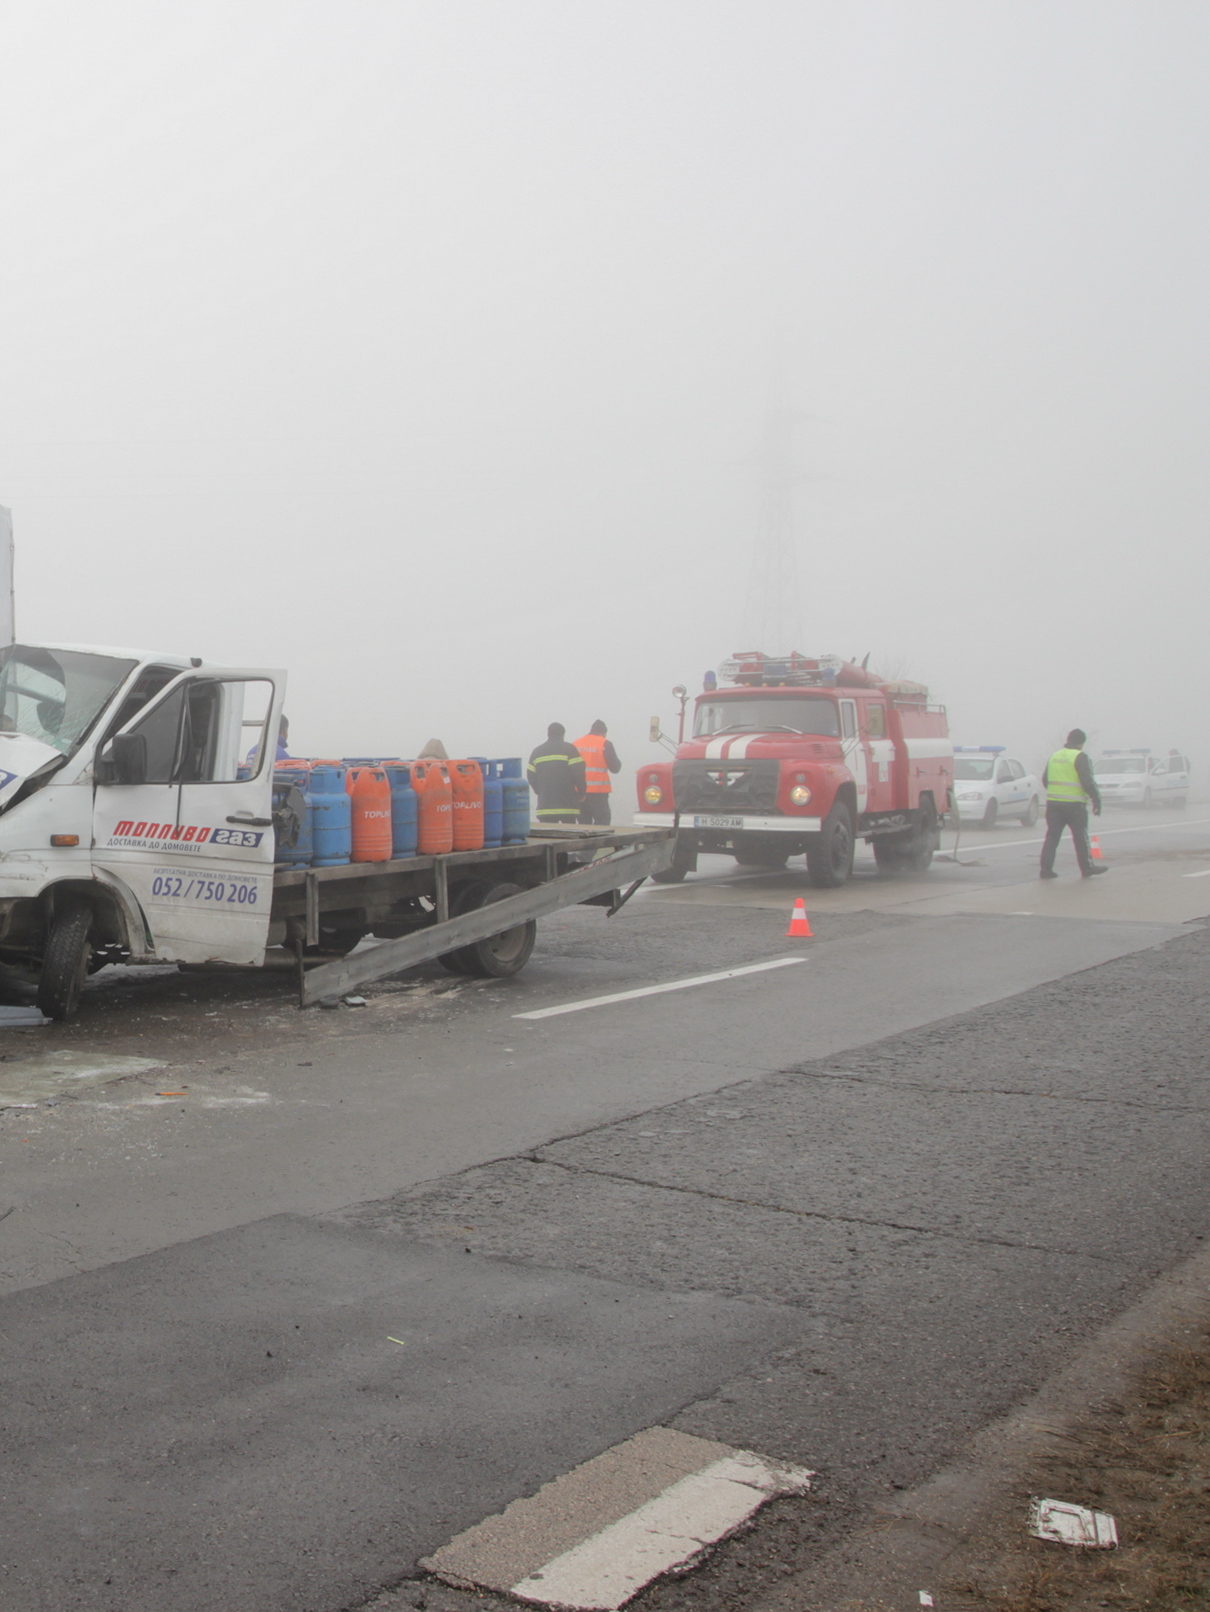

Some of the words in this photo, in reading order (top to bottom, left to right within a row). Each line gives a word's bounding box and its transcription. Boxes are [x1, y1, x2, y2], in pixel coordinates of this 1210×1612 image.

[107, 838, 147, 848] ДОСТАВКА
[148, 841, 160, 850] ДО
[161, 842, 202, 853] ДОМОВЕТЕ
[187, 870, 217, 880] ДОСТАВКА
[226, 874, 258, 884] ДОМОВЕТЕ
